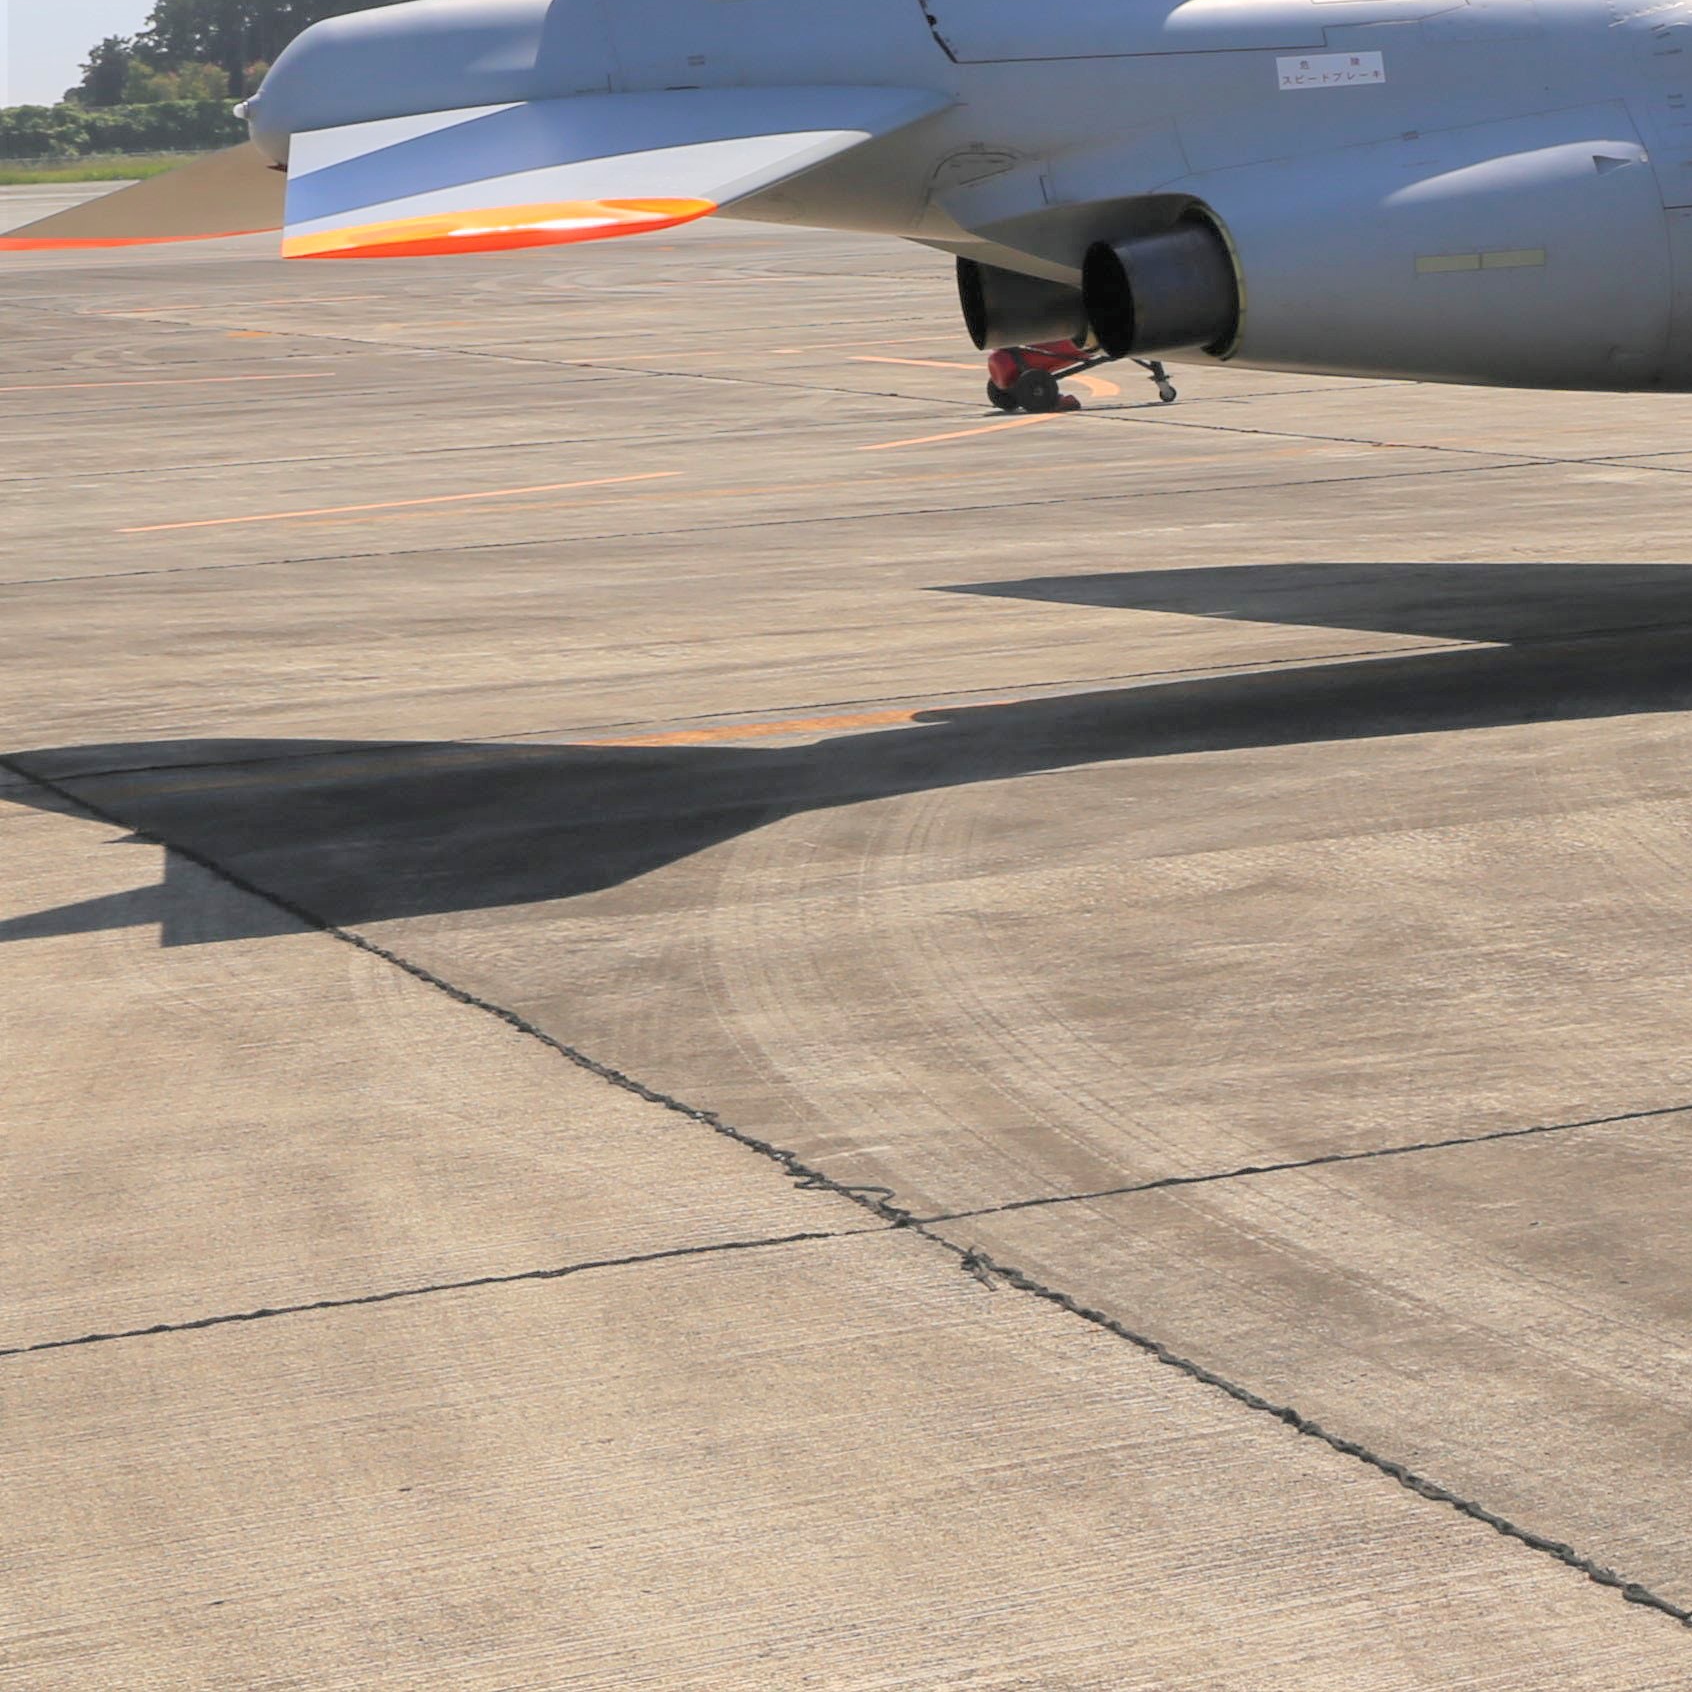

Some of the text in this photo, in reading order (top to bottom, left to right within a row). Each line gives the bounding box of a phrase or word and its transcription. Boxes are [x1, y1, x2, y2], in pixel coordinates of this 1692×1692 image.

[1282, 70, 1381, 85] スピードブレーキ
